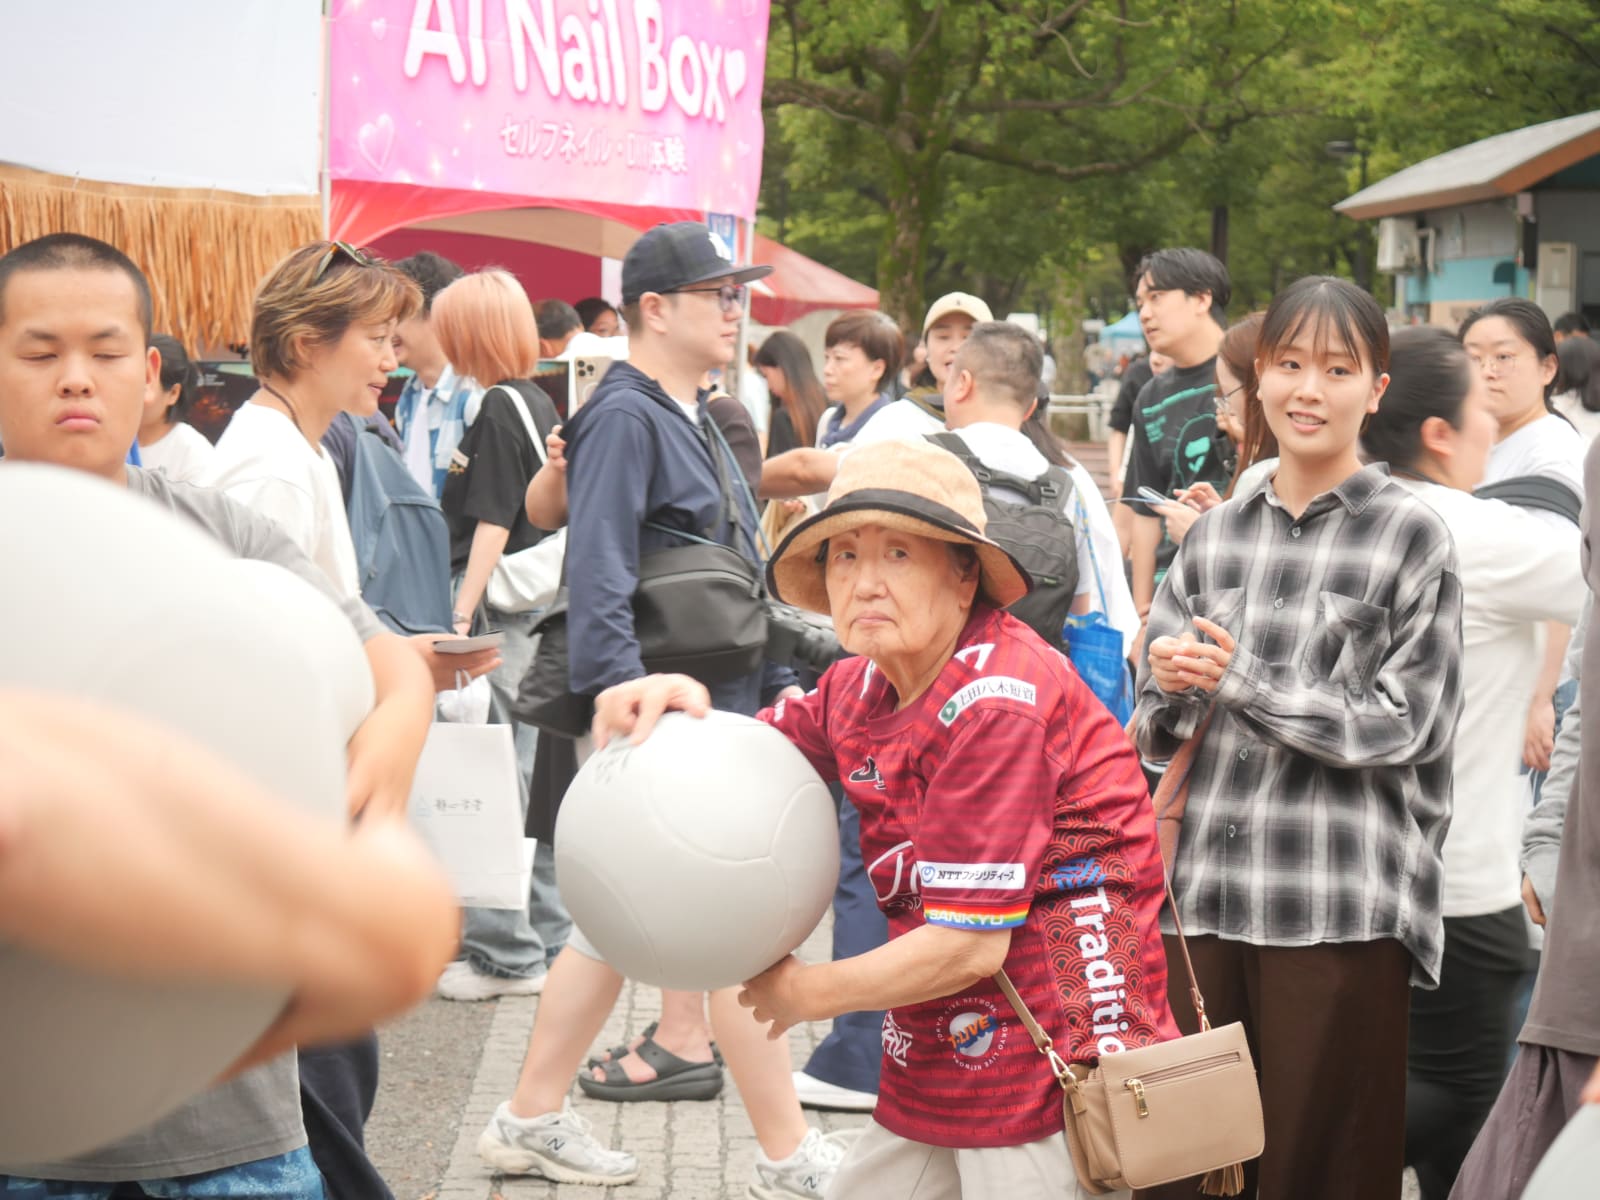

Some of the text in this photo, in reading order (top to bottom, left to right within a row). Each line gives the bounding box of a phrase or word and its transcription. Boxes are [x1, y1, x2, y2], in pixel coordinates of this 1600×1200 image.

[506, 0, 627, 107] Nail
[634, 0, 726, 123] Box
[927, 908, 1005, 926] SANKYU
